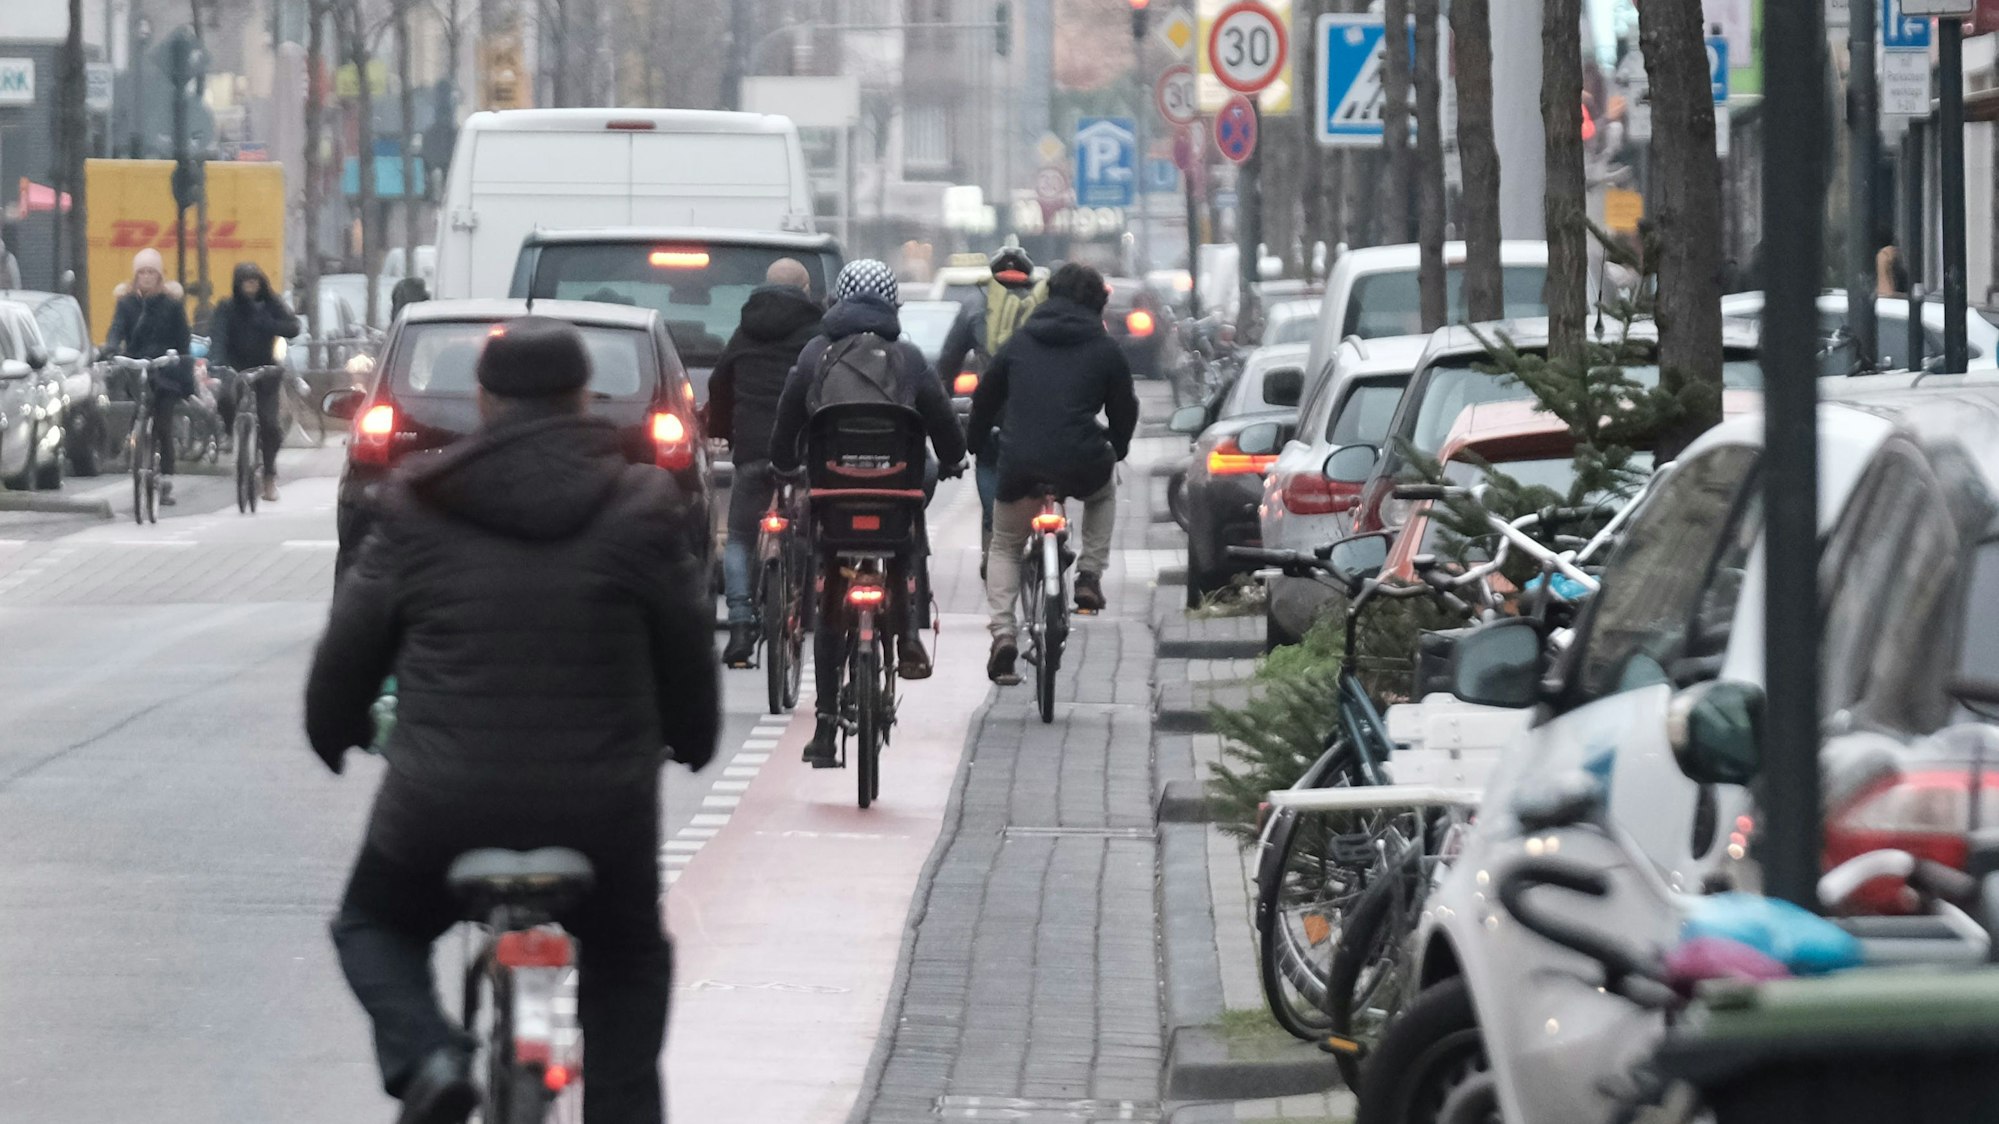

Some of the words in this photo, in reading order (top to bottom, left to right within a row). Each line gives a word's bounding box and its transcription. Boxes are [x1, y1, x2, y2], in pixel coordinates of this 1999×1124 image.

[1224, 25, 1270, 67] 30
[1167, 82, 1196, 109] 30
[110, 219, 244, 249] DHL
